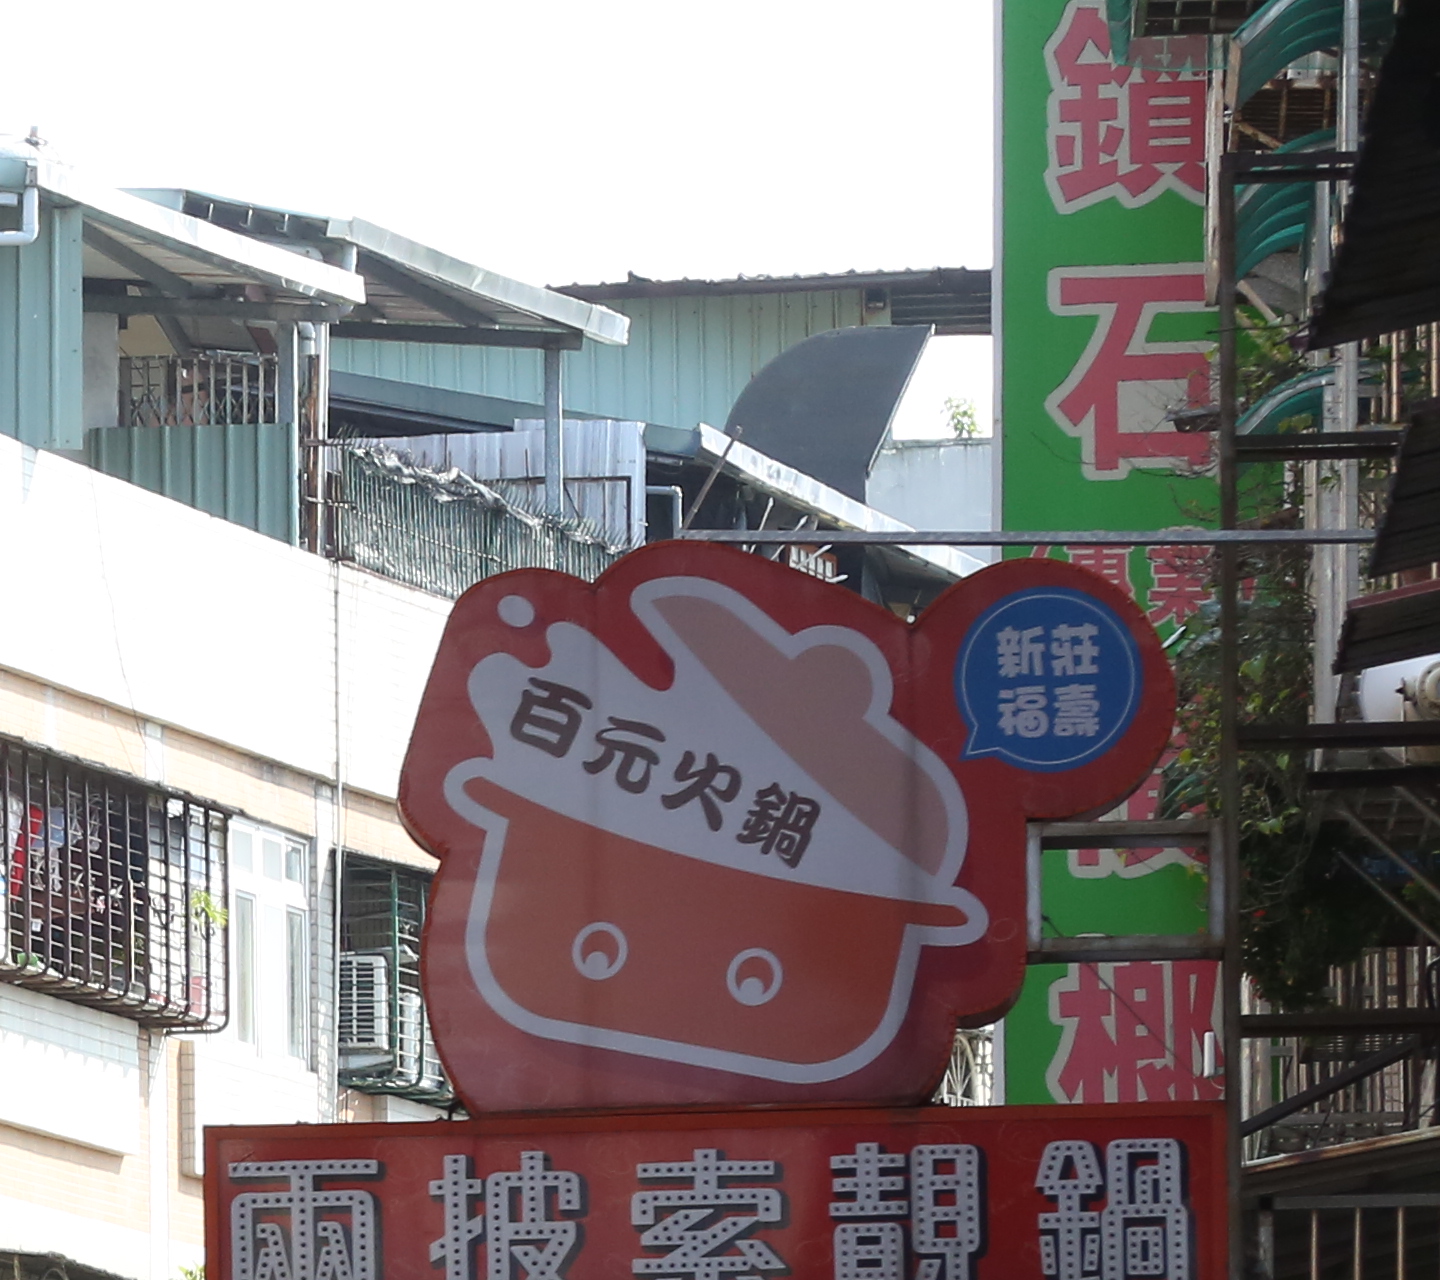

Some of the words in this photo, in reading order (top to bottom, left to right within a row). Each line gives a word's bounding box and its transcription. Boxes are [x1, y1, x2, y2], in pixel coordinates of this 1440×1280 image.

[996, 624, 1100, 675] 新莊
[997, 684, 1101, 740] 福壽
[510, 674, 823, 870] 百元火鍋
